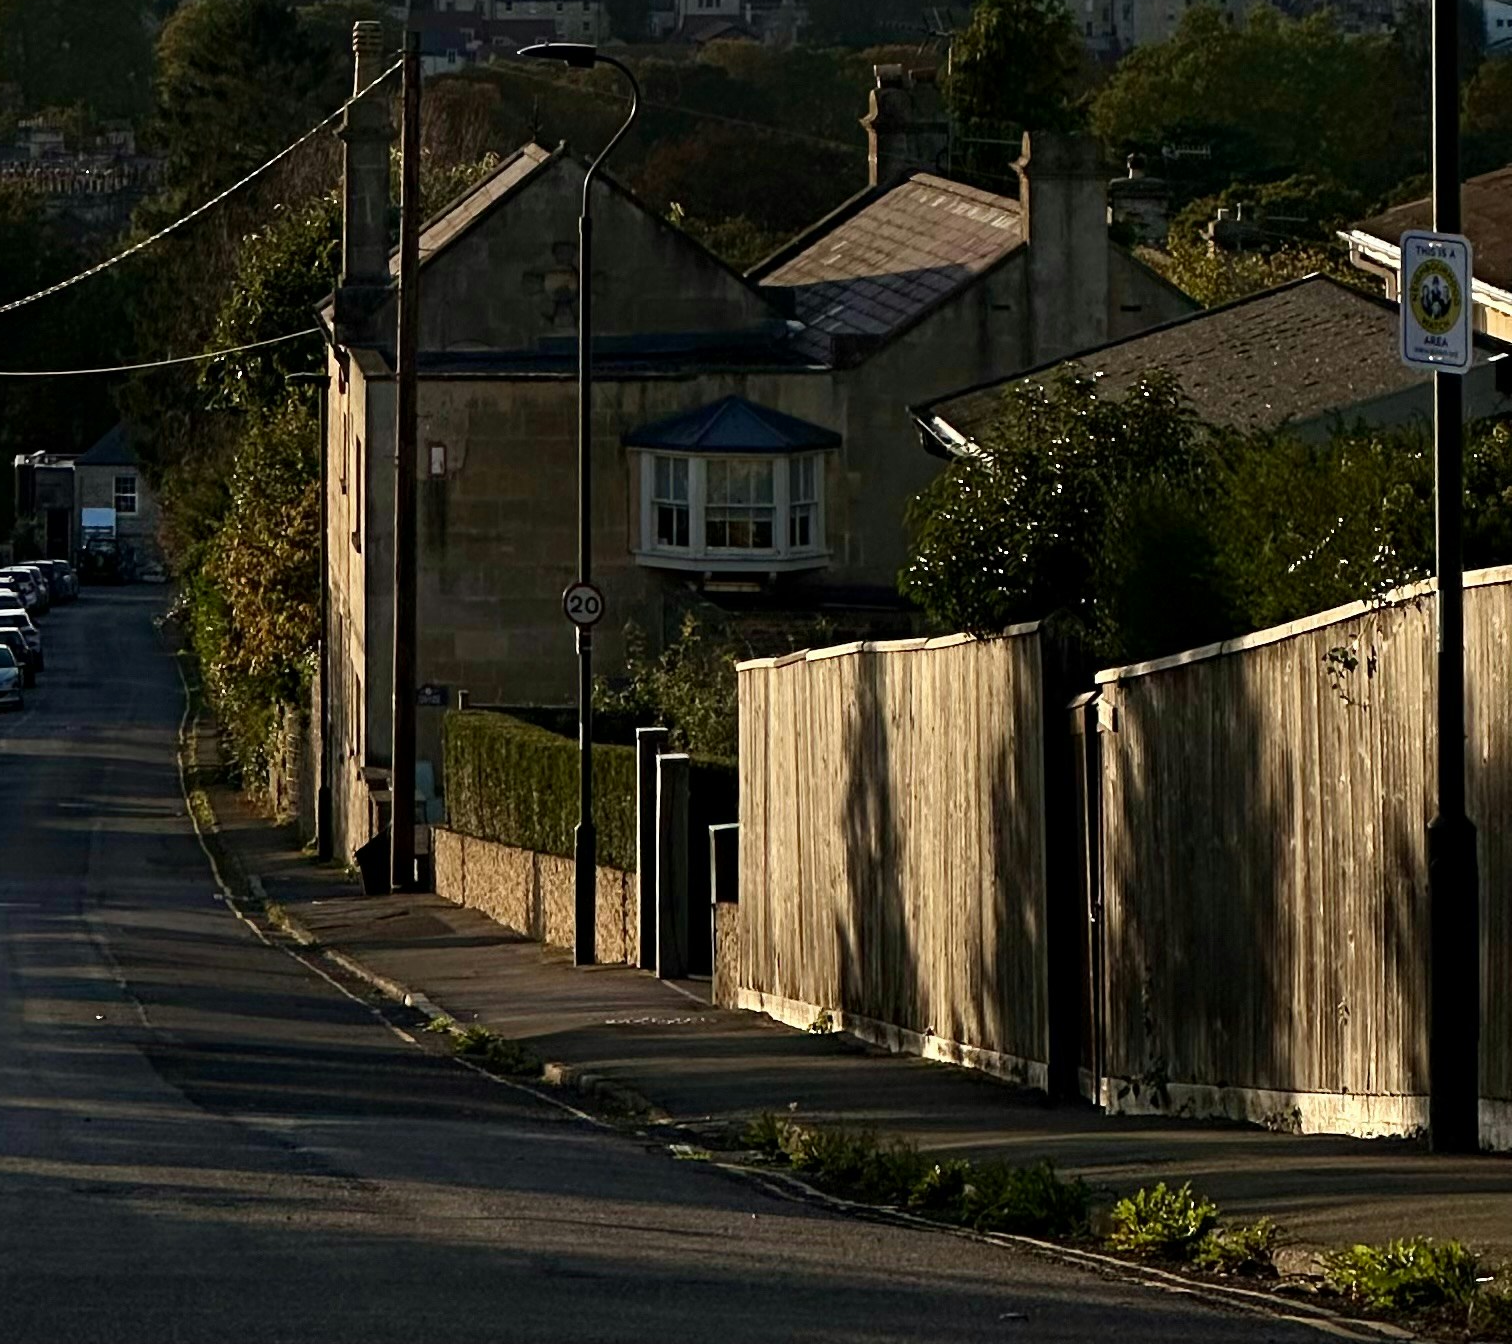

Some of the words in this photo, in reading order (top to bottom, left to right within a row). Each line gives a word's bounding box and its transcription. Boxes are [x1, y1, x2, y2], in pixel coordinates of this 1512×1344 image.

[1416, 246, 1436, 257] THIS
[1438, 247, 1447, 258] IS
[1449, 249, 1456, 259] A
[1424, 335, 1448, 347] AREA
[570, 595, 599, 614] 20
